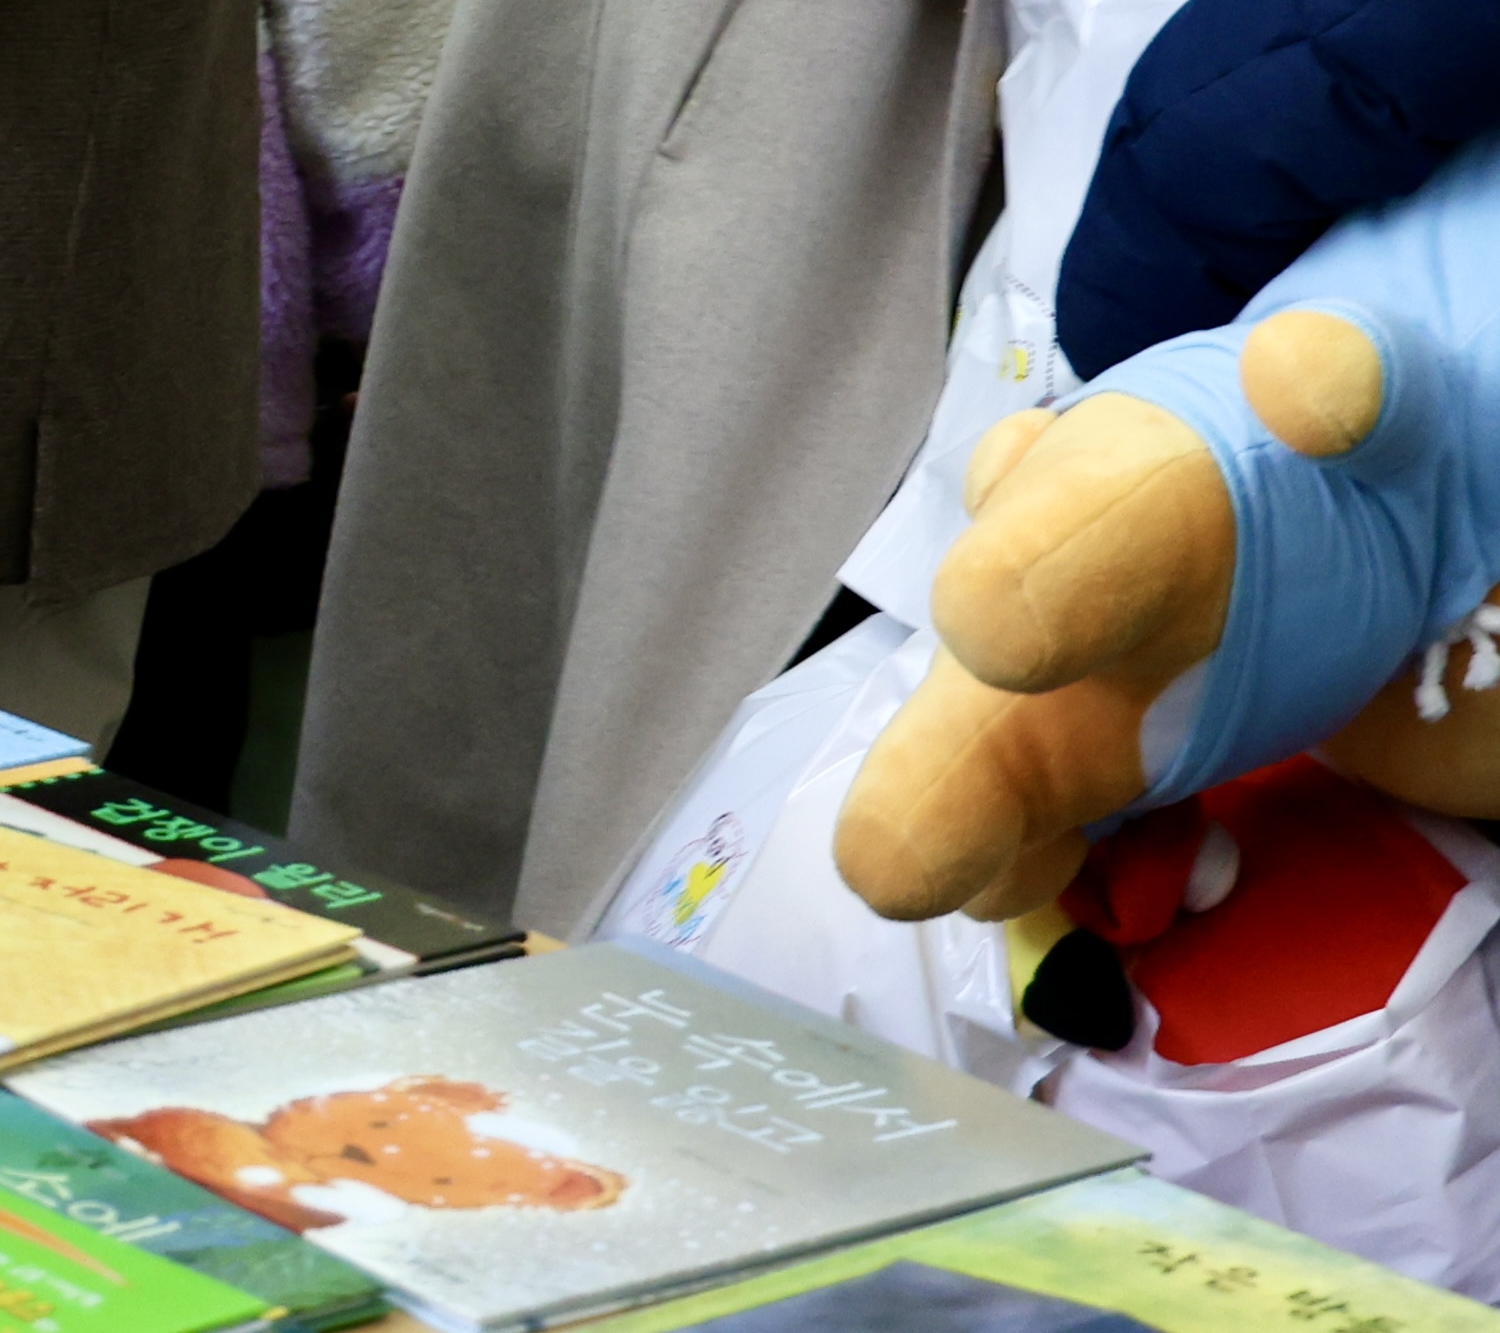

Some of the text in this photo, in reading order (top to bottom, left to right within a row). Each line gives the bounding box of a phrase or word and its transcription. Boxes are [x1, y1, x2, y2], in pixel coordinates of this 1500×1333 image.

[87, 795, 258, 863] 겁쟁이
[593, 984, 963, 1147] 눈 속에서
